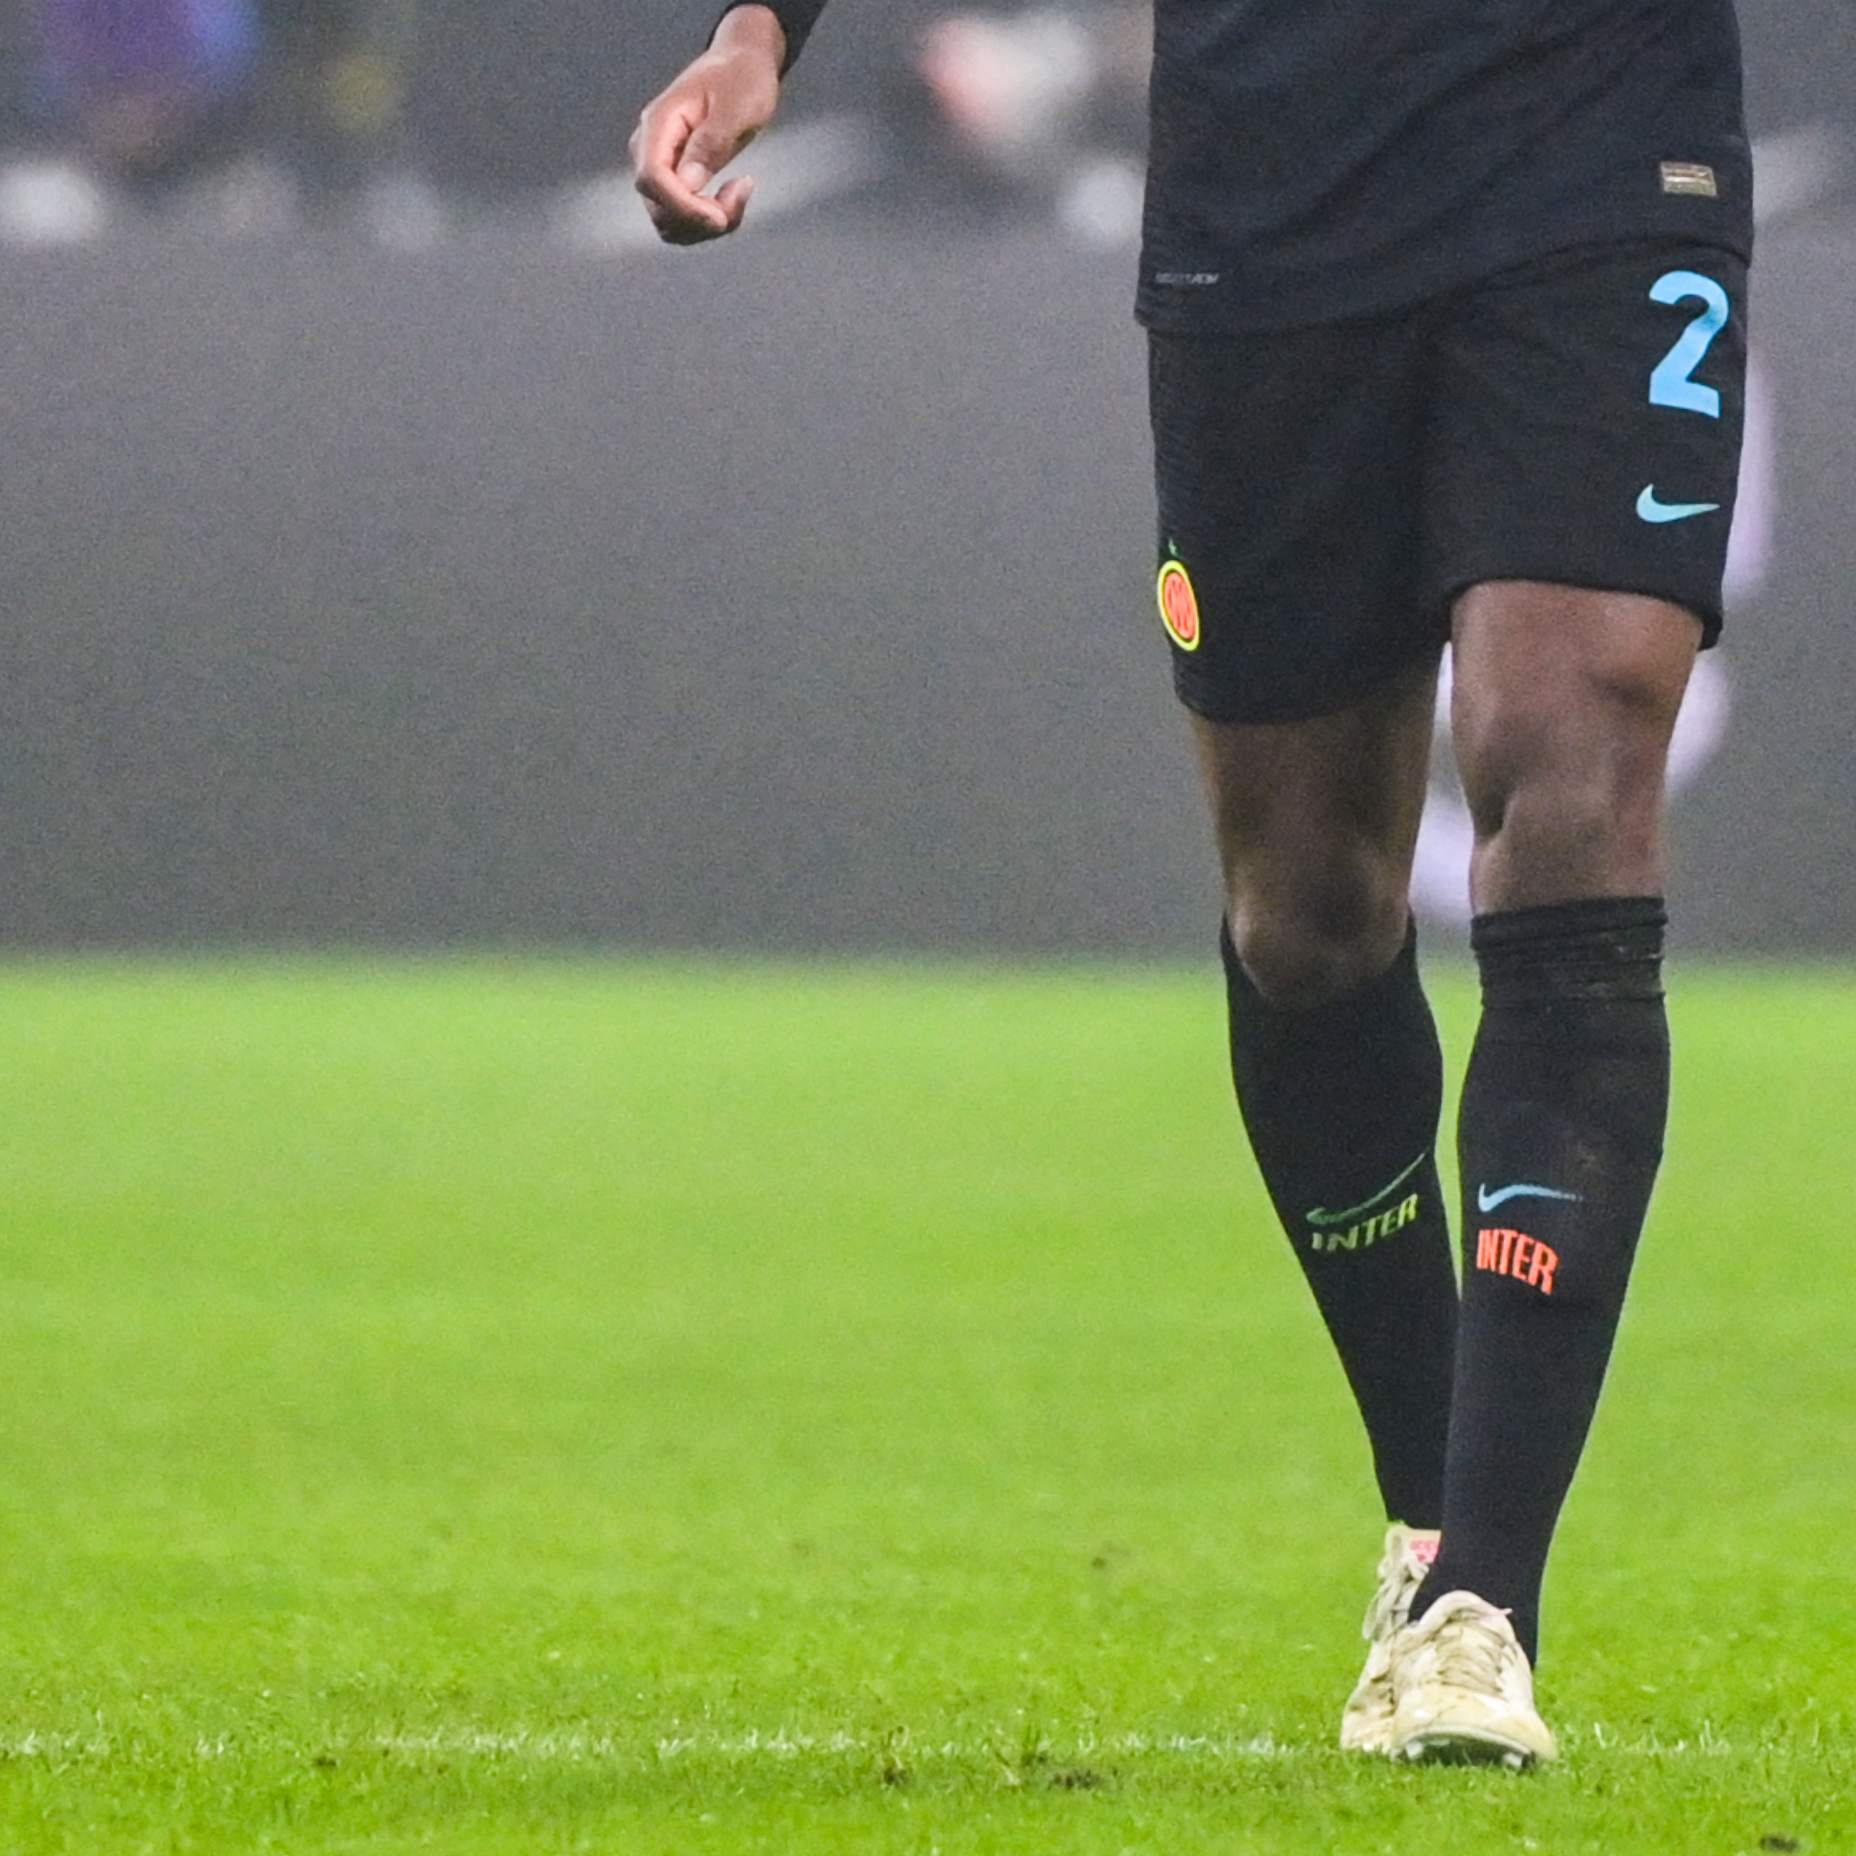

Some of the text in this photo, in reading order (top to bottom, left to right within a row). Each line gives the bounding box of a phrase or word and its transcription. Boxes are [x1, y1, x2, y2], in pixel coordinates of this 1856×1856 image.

[1648, 270, 1730, 419] 2
[1311, 1192, 1419, 1252] INTER
[1475, 1227, 1560, 1297] INTER
